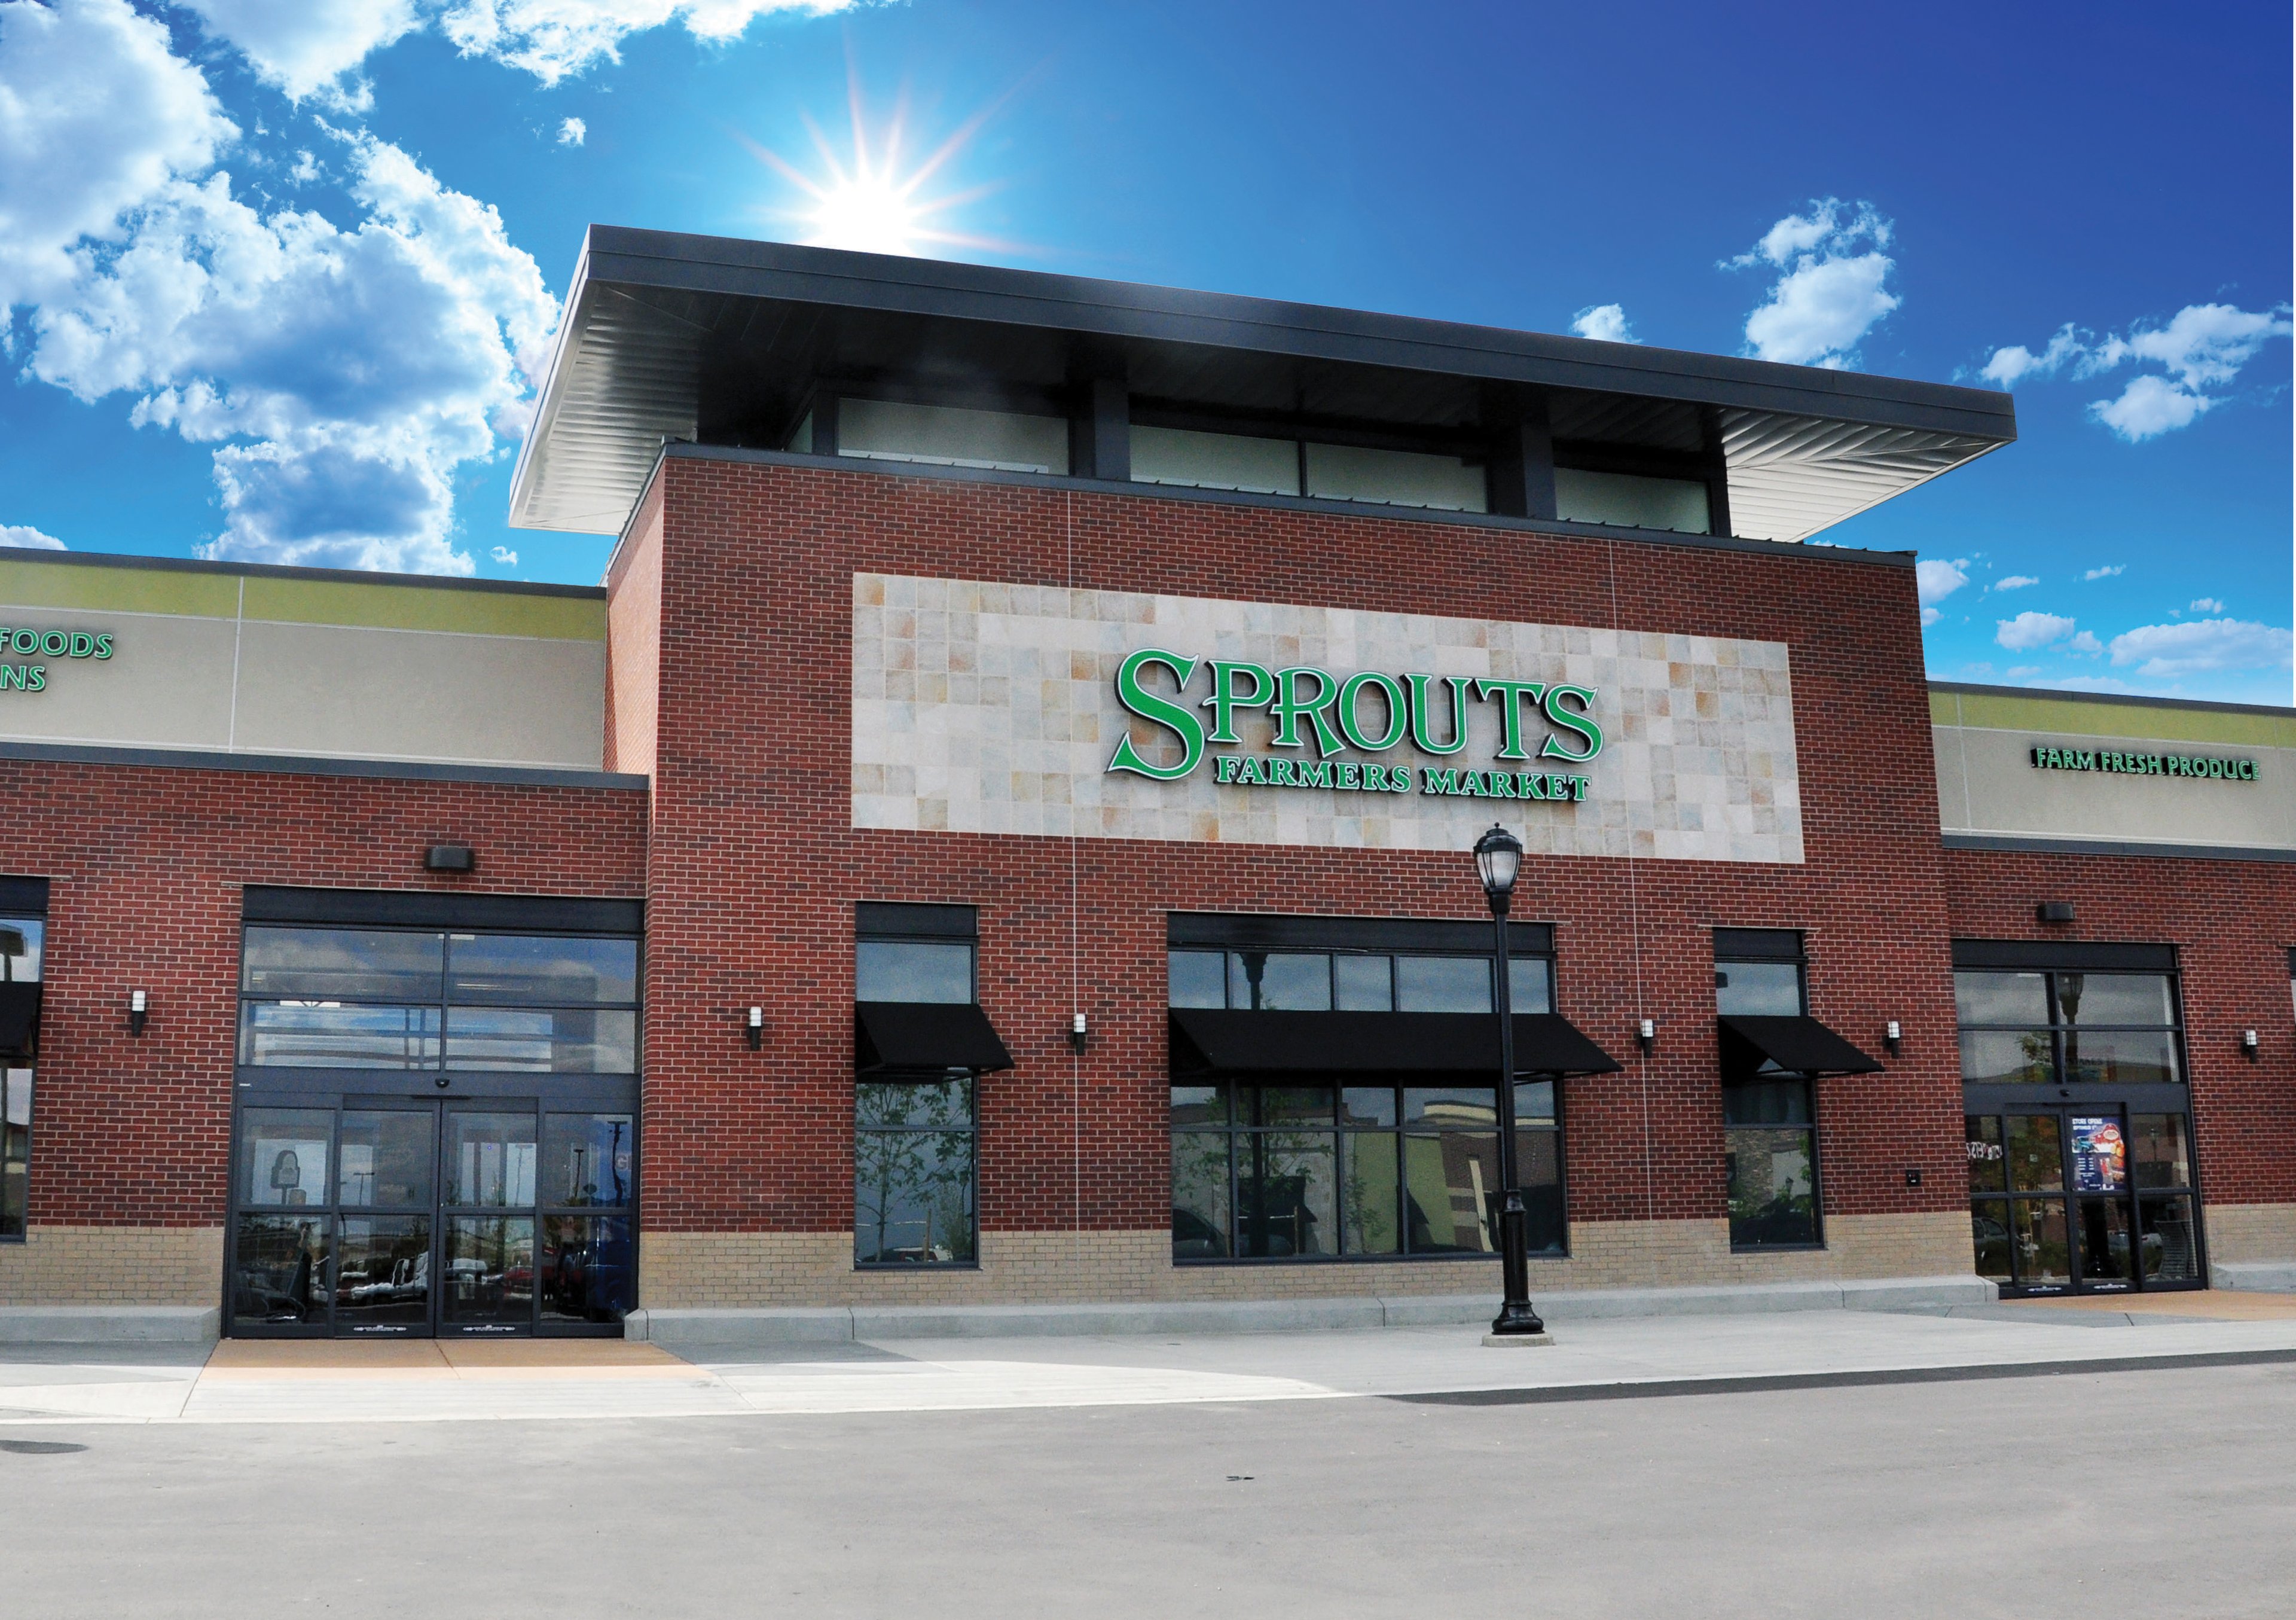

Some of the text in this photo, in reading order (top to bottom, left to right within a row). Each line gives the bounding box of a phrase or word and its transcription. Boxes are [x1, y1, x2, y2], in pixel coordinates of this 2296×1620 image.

[1108, 648, 1605, 781] SPROUTS
[1215, 755, 1592, 803] FARMERS MARKET
[2036, 747, 2262, 780] FARM FRESH PRODUCE
